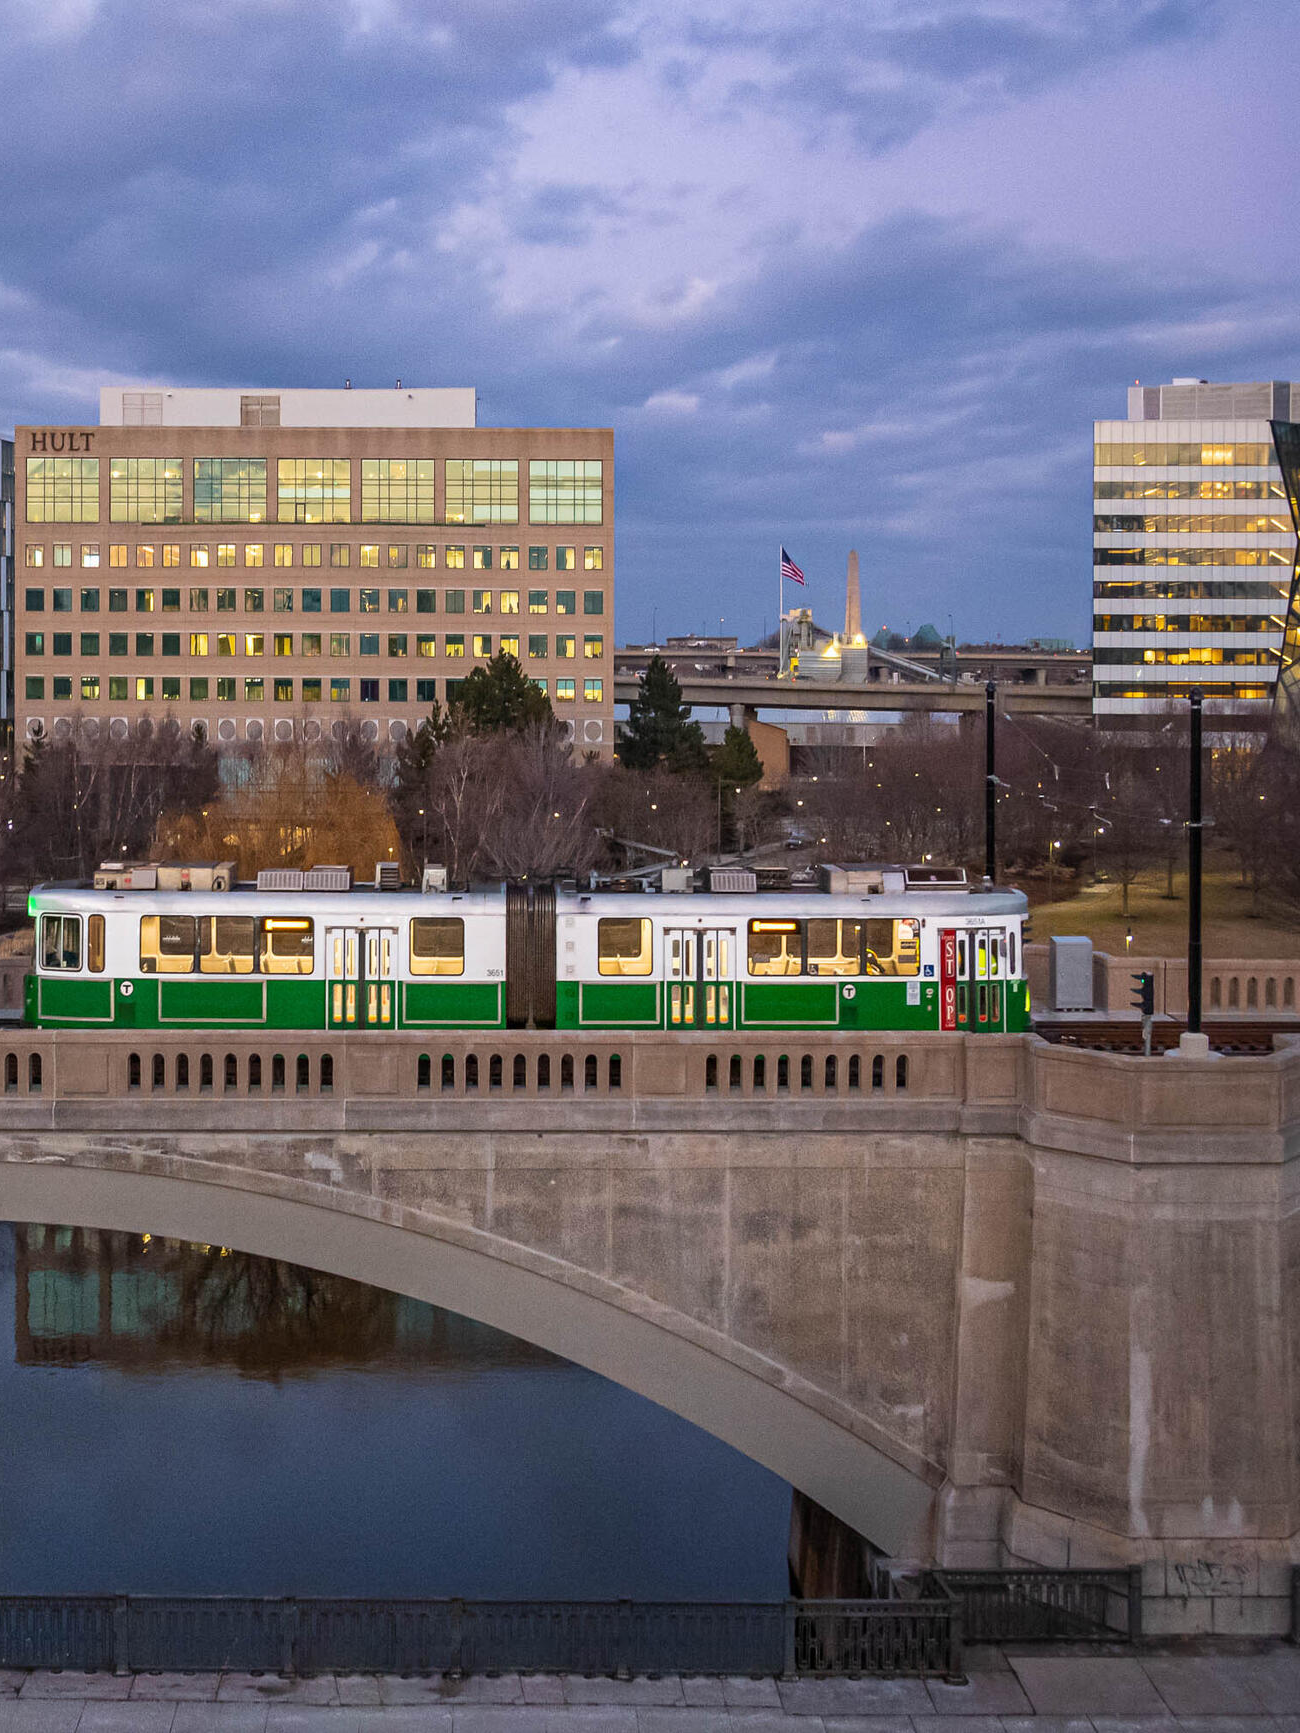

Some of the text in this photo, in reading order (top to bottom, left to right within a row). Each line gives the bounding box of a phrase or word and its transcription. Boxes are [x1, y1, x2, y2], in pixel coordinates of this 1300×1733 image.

[31, 432, 95, 452] HULT
[486, 968, 504, 977] 3651
[946, 941, 954, 1020] STOP
